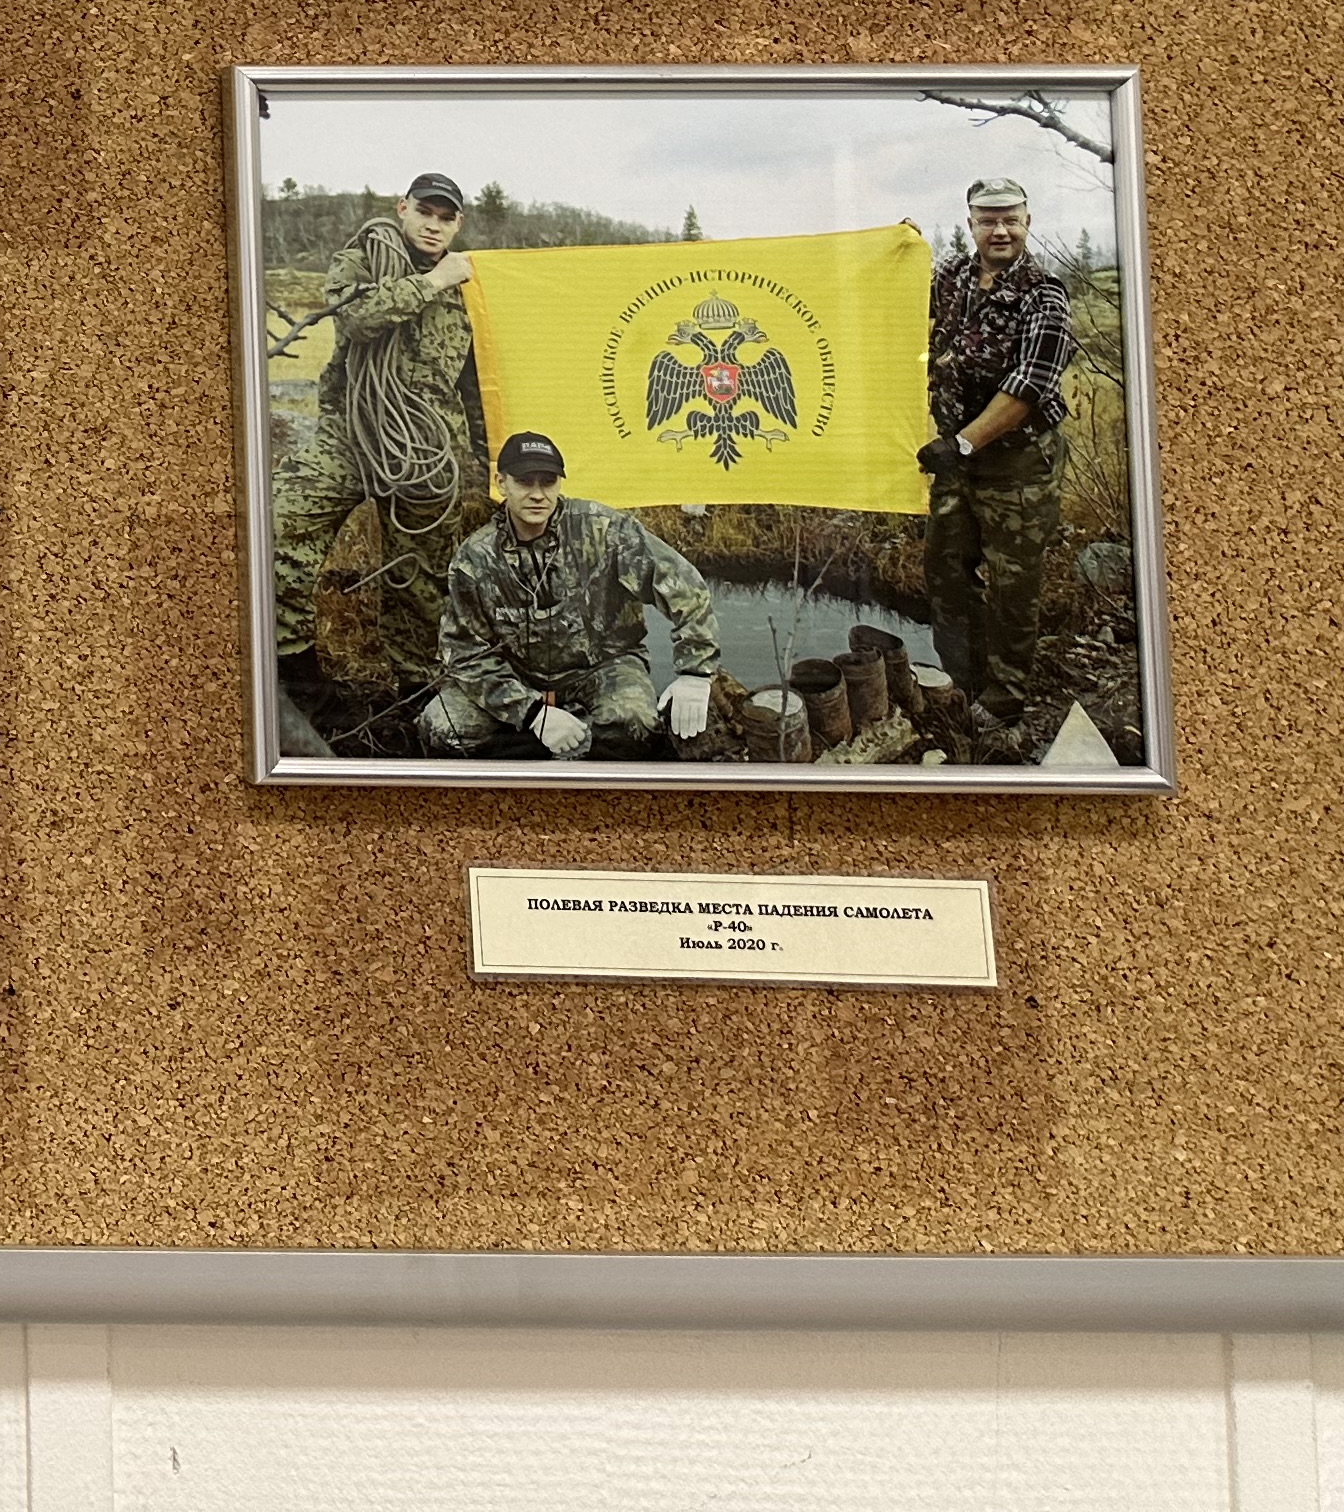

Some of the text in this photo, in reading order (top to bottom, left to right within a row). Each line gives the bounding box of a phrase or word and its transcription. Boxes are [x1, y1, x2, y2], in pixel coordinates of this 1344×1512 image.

[598, 269, 836, 439] РОССИЙСКОЕ ВОЕННО-ИСТОРИЧЕСКОЕ ОБЩЕСТВО
[525, 897, 934, 921] ПОЛЕВАЯ РАЗВЕДКА МЕСТА ПАДЕНИЯ САМОЛЕТА
[678, 936, 784, 952] Июль 2020 г.
